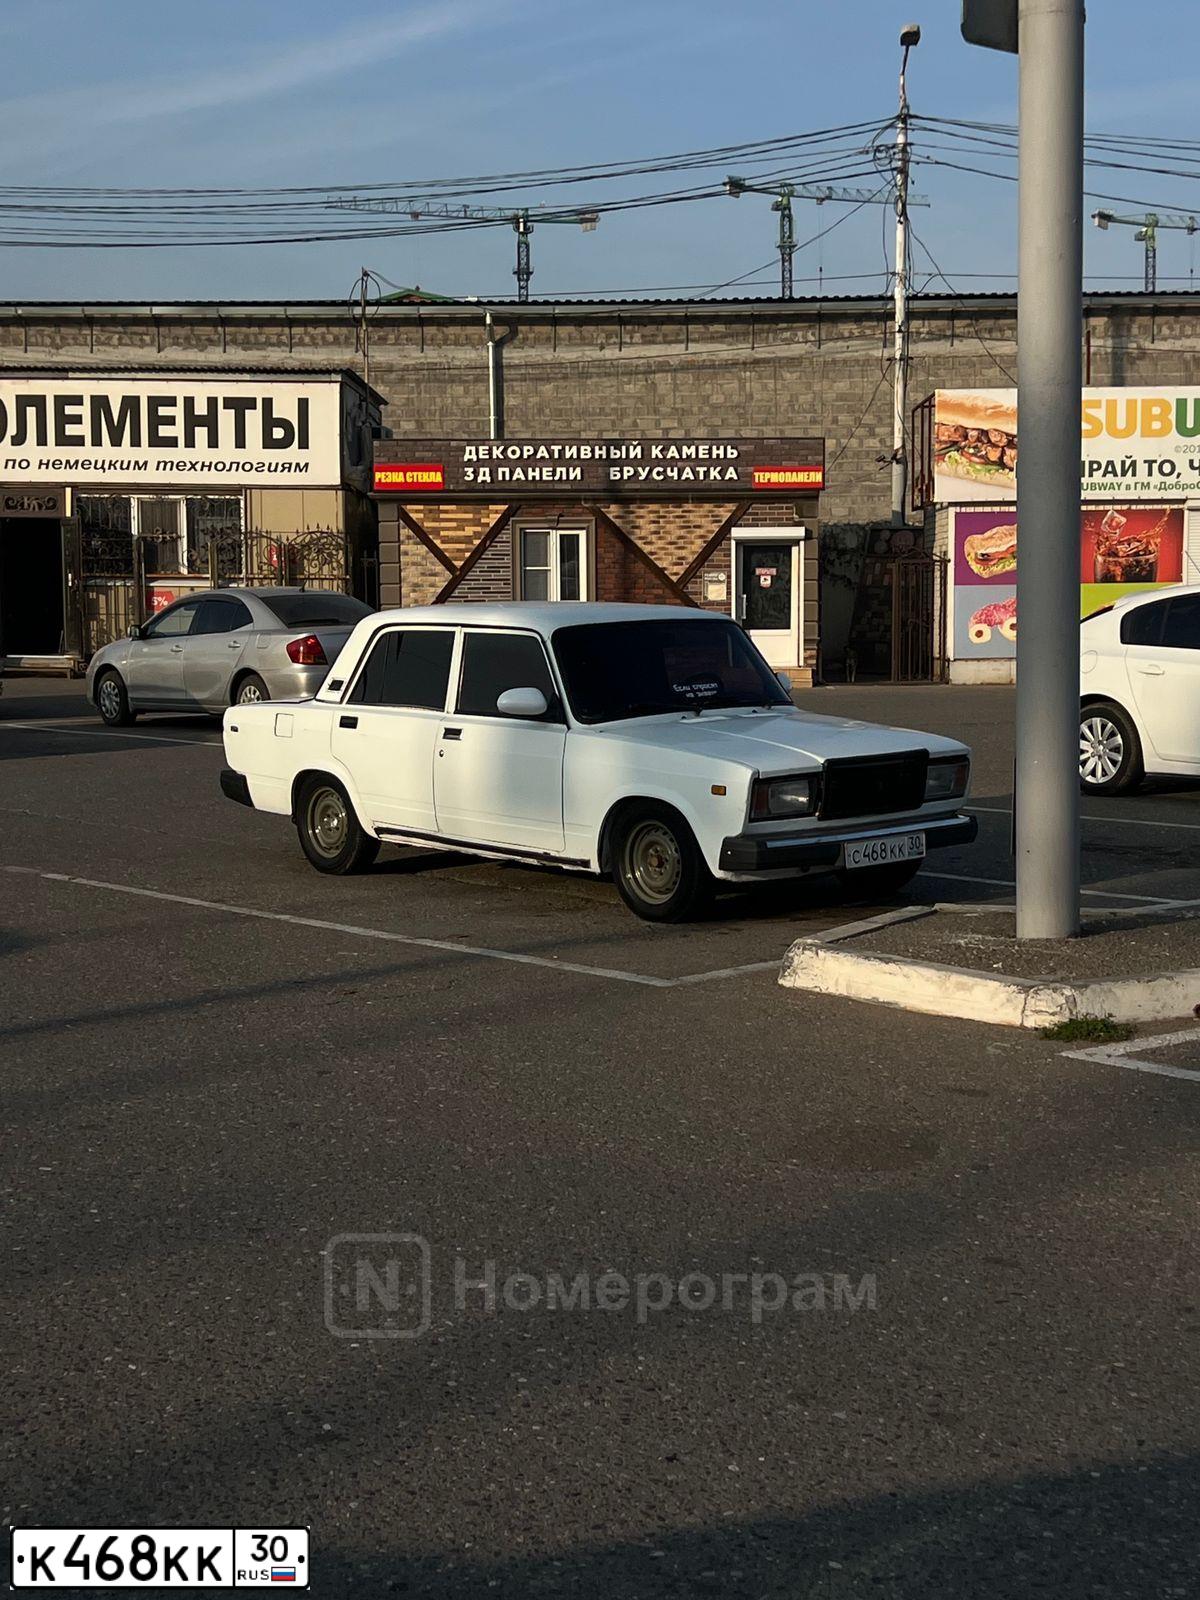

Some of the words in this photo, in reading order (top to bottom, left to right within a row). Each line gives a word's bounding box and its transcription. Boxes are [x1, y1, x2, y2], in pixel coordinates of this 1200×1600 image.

[0, 394, 309, 450] ЛЕМЕНТЫ
[463, 441, 642, 462] ДЕКОРАТИВНЫЙ
[651, 445, 739, 459] КАМЕНЬ
[4, 458, 31, 470] по
[37, 458, 149, 473] немецким
[155, 460, 309, 473] технологиям
[497, 466, 582, 481] ПАНЕЛИ
[609, 466, 739, 481] БРУСЧАТКА
[1143, 459, 1182, 480] ТО,
[375, 471, 405, 483] РЕЗКА
[405, 471, 443, 483] СТЕКЛА
[753, 471, 823, 483] ТЕРМОПАНЕЛИ
[851, 842, 905, 864] С468КК
[908, 836, 921, 850] 30
